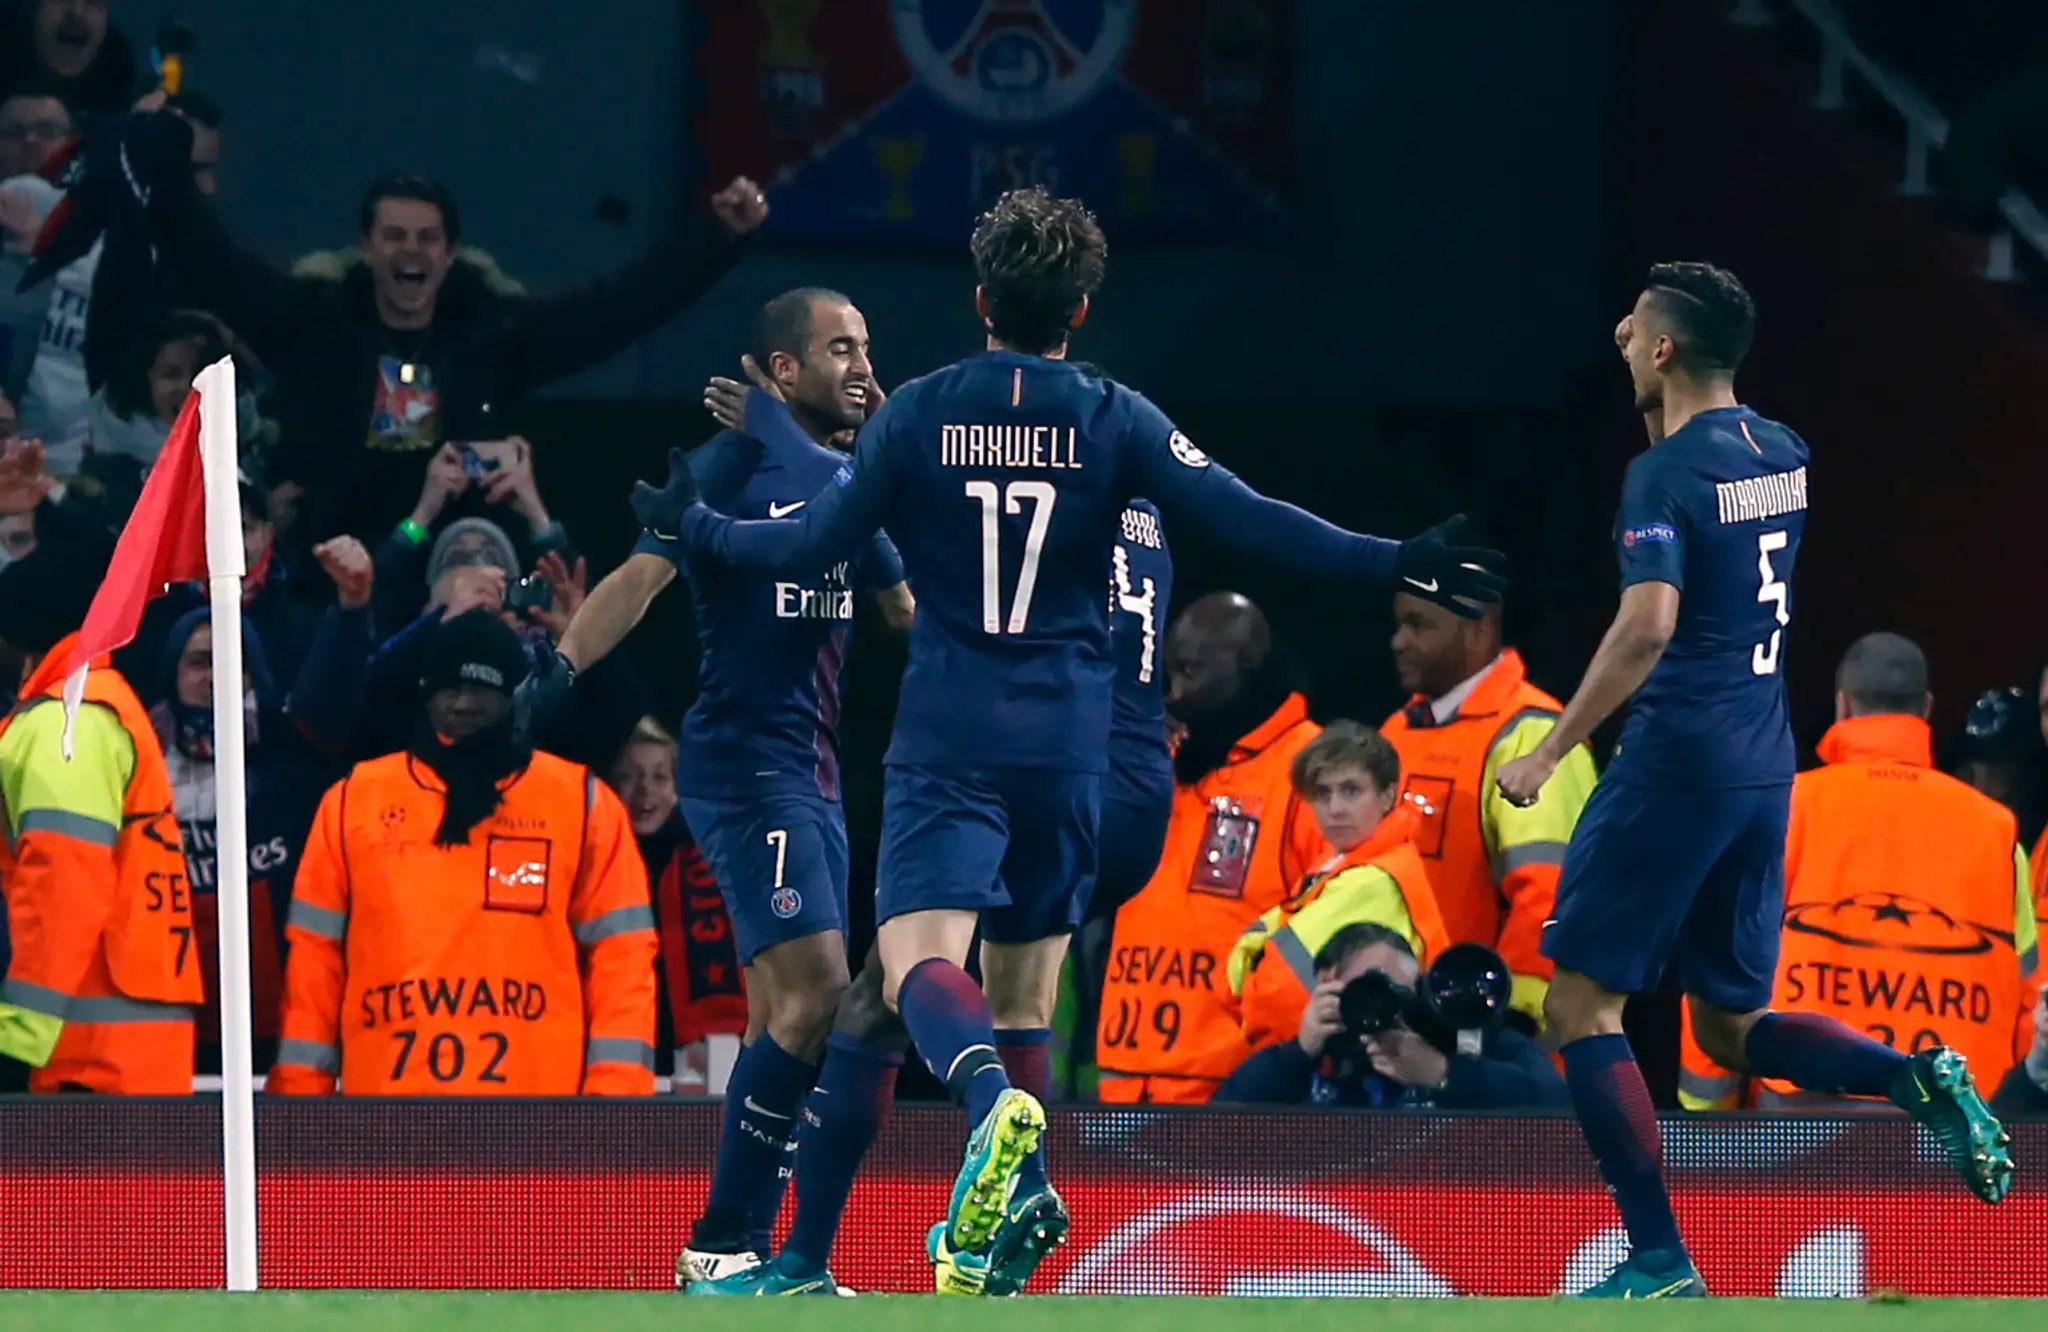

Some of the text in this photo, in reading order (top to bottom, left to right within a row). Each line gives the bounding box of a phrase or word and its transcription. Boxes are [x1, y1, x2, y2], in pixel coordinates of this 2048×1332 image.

[941, 425, 1083, 468] MAXWELL
[965, 481, 1056, 634] 17
[775, 582, 853, 619] Emira
[1109, 545, 1156, 684] 4
[1752, 531, 1790, 675] 5
[766, 829, 788, 889] 7
[361, 977, 547, 1029] STEWARD
[1785, 961, 1991, 1023] STEWARD
[390, 1030, 509, 1083] 702
